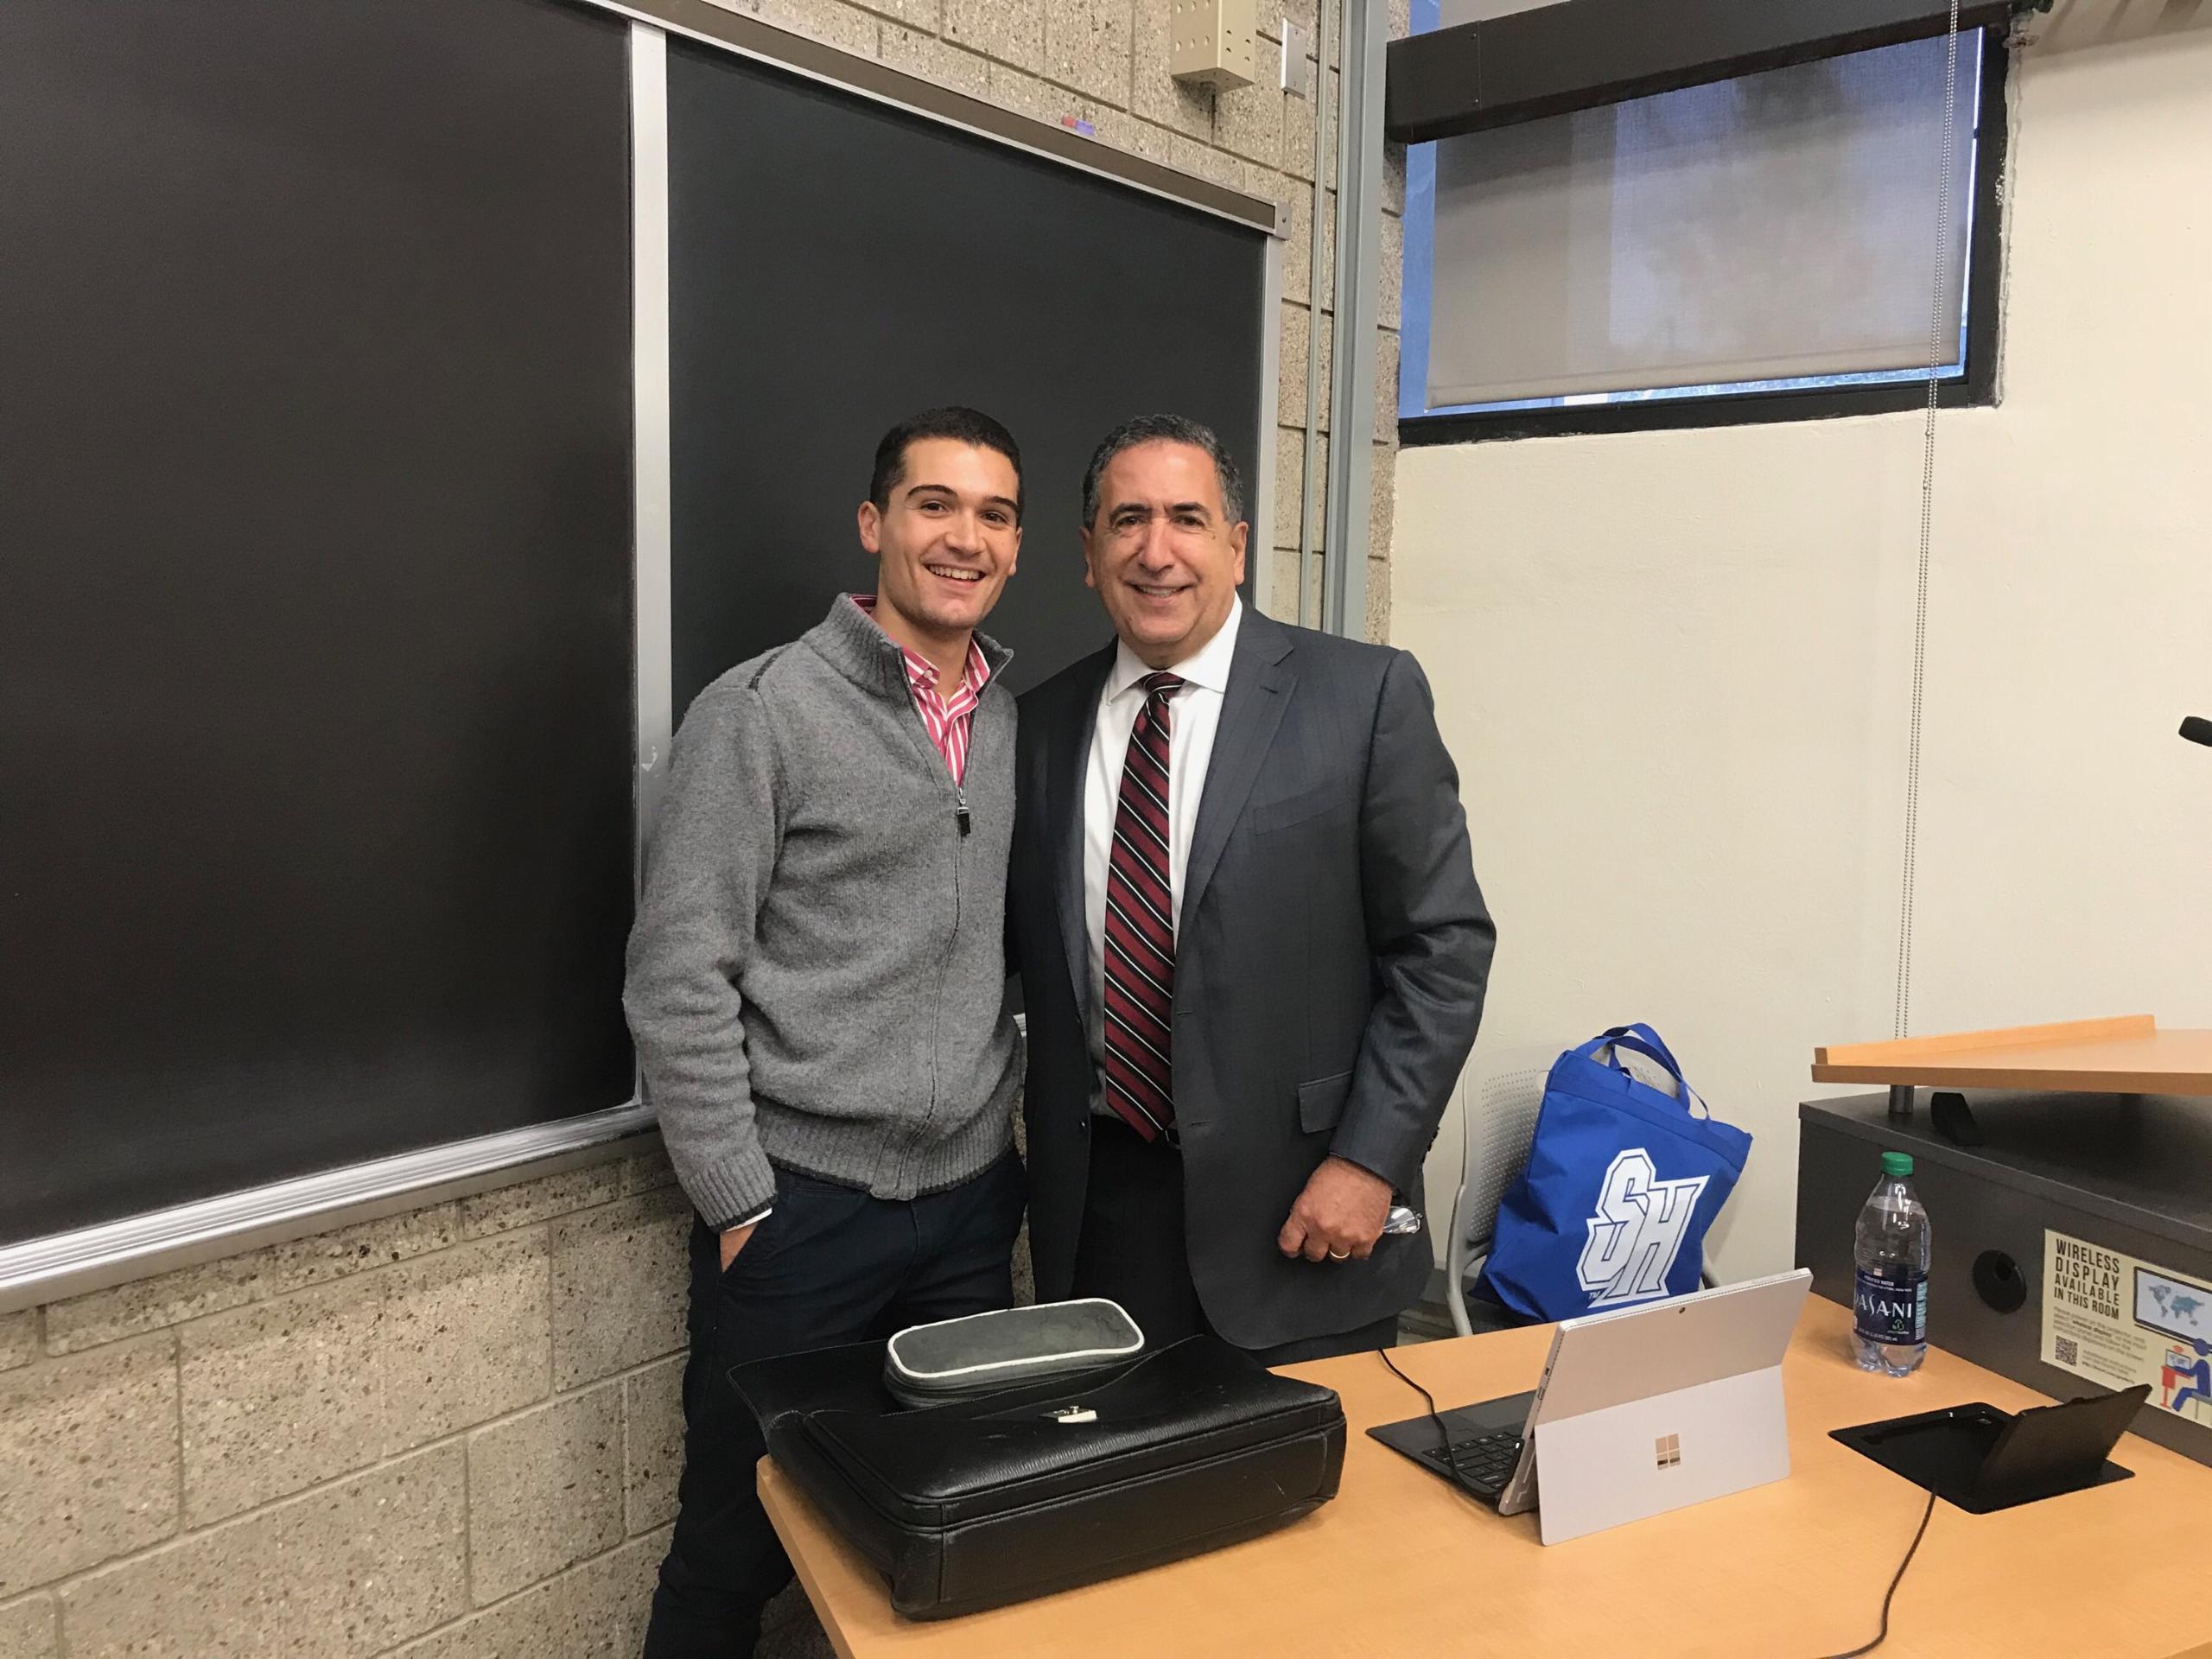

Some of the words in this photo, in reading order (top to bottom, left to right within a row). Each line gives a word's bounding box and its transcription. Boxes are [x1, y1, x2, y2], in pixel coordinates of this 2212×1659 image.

[2056, 1238, 2120, 1274] WIRELESS
[2054, 1273, 2120, 1306] AVAILABLE
[2056, 1256, 2120, 1291] DISPLAY
[2054, 1287, 2064, 1300] IN
[2067, 1290, 2088, 1309] THIS
[2092, 1300, 2120, 1320] ROOM
